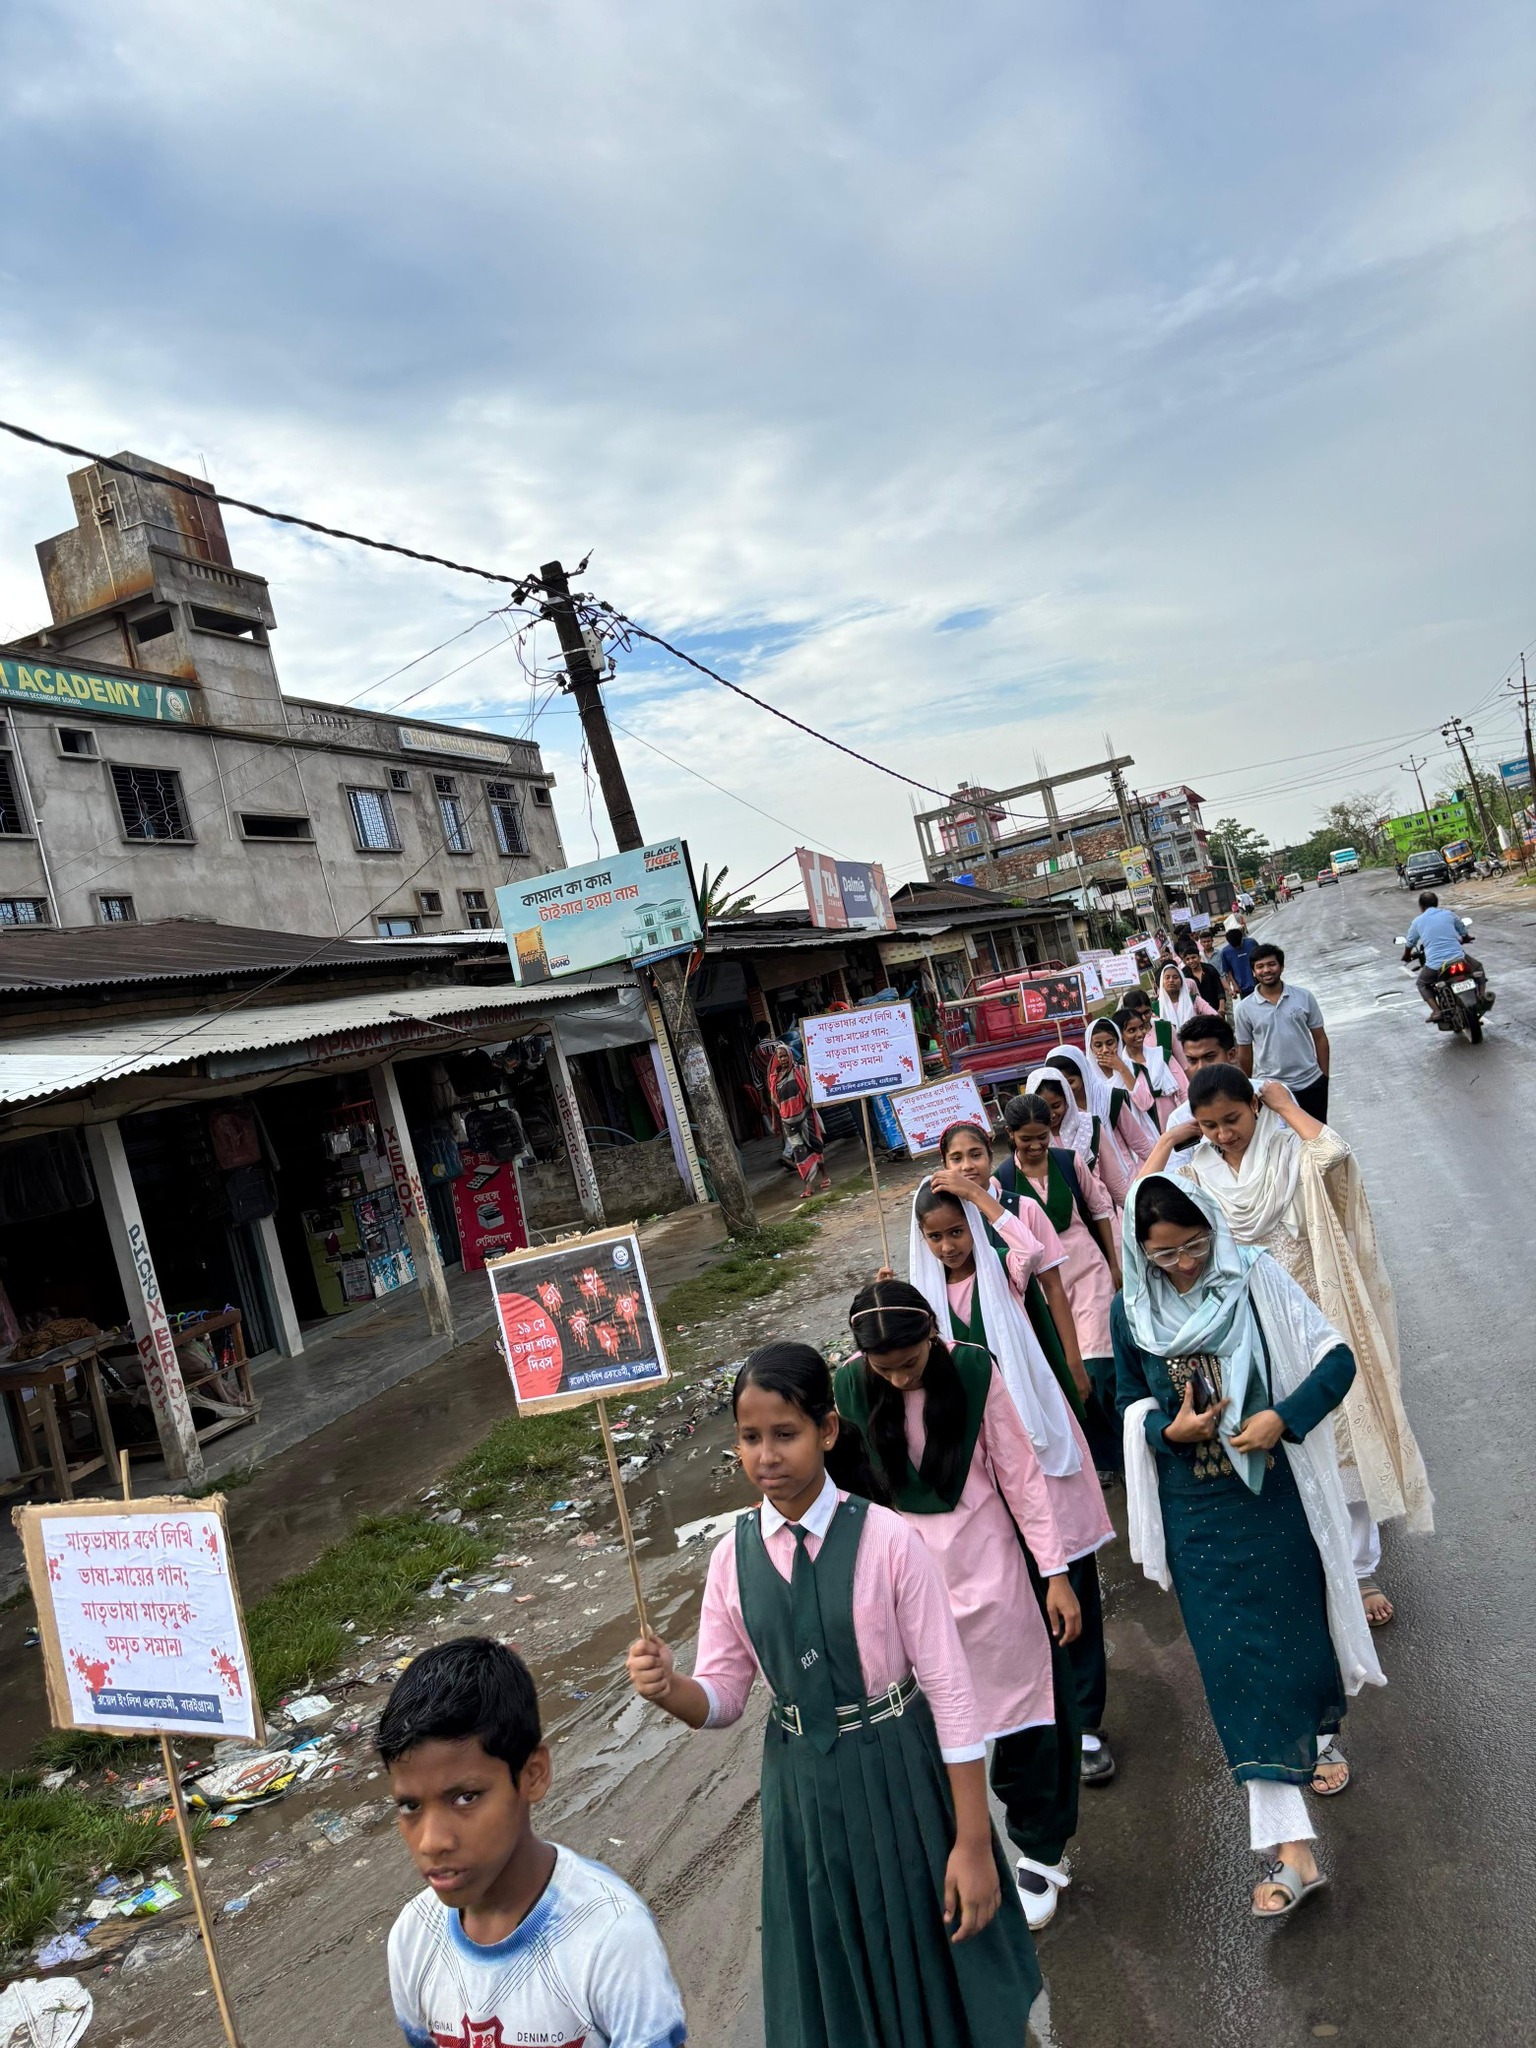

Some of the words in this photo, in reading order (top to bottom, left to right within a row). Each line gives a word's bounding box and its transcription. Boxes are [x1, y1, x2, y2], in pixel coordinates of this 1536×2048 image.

[17, 665, 141, 708] ACADEMY
[410, 729, 438, 747] ROYAL
[440, 734, 475, 754] ENGLISH
[475, 741, 509, 759] ACADEMY
[643, 844, 677, 860] BLACK
[644, 852, 679, 869] TIGER
[520, 884, 564, 908] কামাল
[565, 879, 583, 895] কা
[584, 871, 613, 890] কাম
[821, 869, 840, 899] TAJ
[842, 876, 866, 893] Dalmia
[538, 899, 584, 922] টাইগার
[614, 883, 640, 902] নাম
[550, 959, 571, 970] BOND
[817, 1018, 857, 1033] মাতৃভাষার
[824, 1045, 860, 1060] মাতৃভাষা
[837, 1059, 859, 1071] অমৃত
[385, 1126, 415, 1217] XEROX
[452, 1182, 466, 1238] PHOTO
[509, 1170, 525, 1227] PHOTO
[517, 1323, 531, 1335] ১৯
[532, 1318, 546, 1332] মে
[512, 1341, 535, 1355] ভাষা
[536, 1335, 559, 1350] শহিদ
[147, 1297, 186, 1424] XEROX
[527, 1354, 554, 1372] দিবস
[65, 1529, 130, 1558] মাতৃভাষার
[133, 1522, 159, 1550] বর্ণে
[160, 1521, 195, 1549] লিখি
[77, 1564, 156, 1588] ভাষা-মায়ের
[157, 1567, 189, 1591] গান;
[81, 1601, 141, 1627] মাতৃভাষা
[105, 1635, 140, 1662] অমৃত
[144, 1636, 183, 1657] সমান।
[800, 1648, 819, 1670] REA
[117, 1692, 142, 1709] ইংলিশ
[517, 2031, 549, 2043] DENIM
